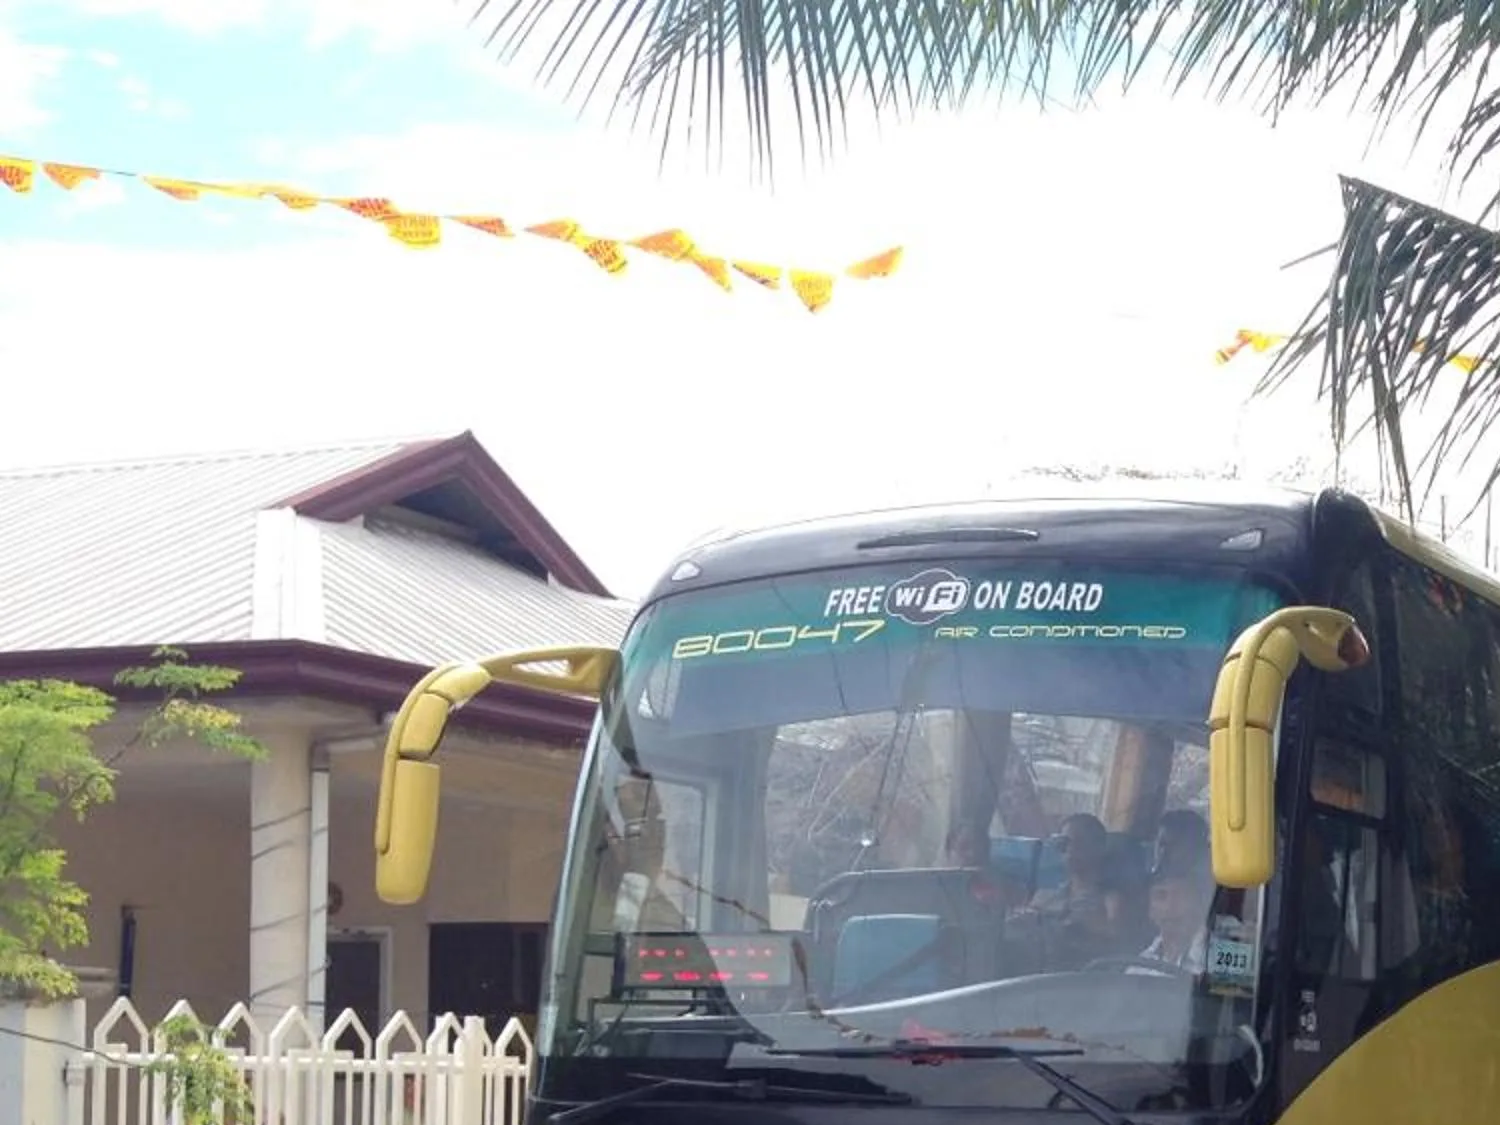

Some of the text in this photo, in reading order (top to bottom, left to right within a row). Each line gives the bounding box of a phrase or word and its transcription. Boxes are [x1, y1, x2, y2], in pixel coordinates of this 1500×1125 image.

[824, 585, 886, 616] FREE
[973, 581, 1012, 610] ON
[1015, 582, 1104, 611] BOARD
[672, 619, 885, 659] 80047
[934, 625, 1187, 640] AIR CONDITIONED
